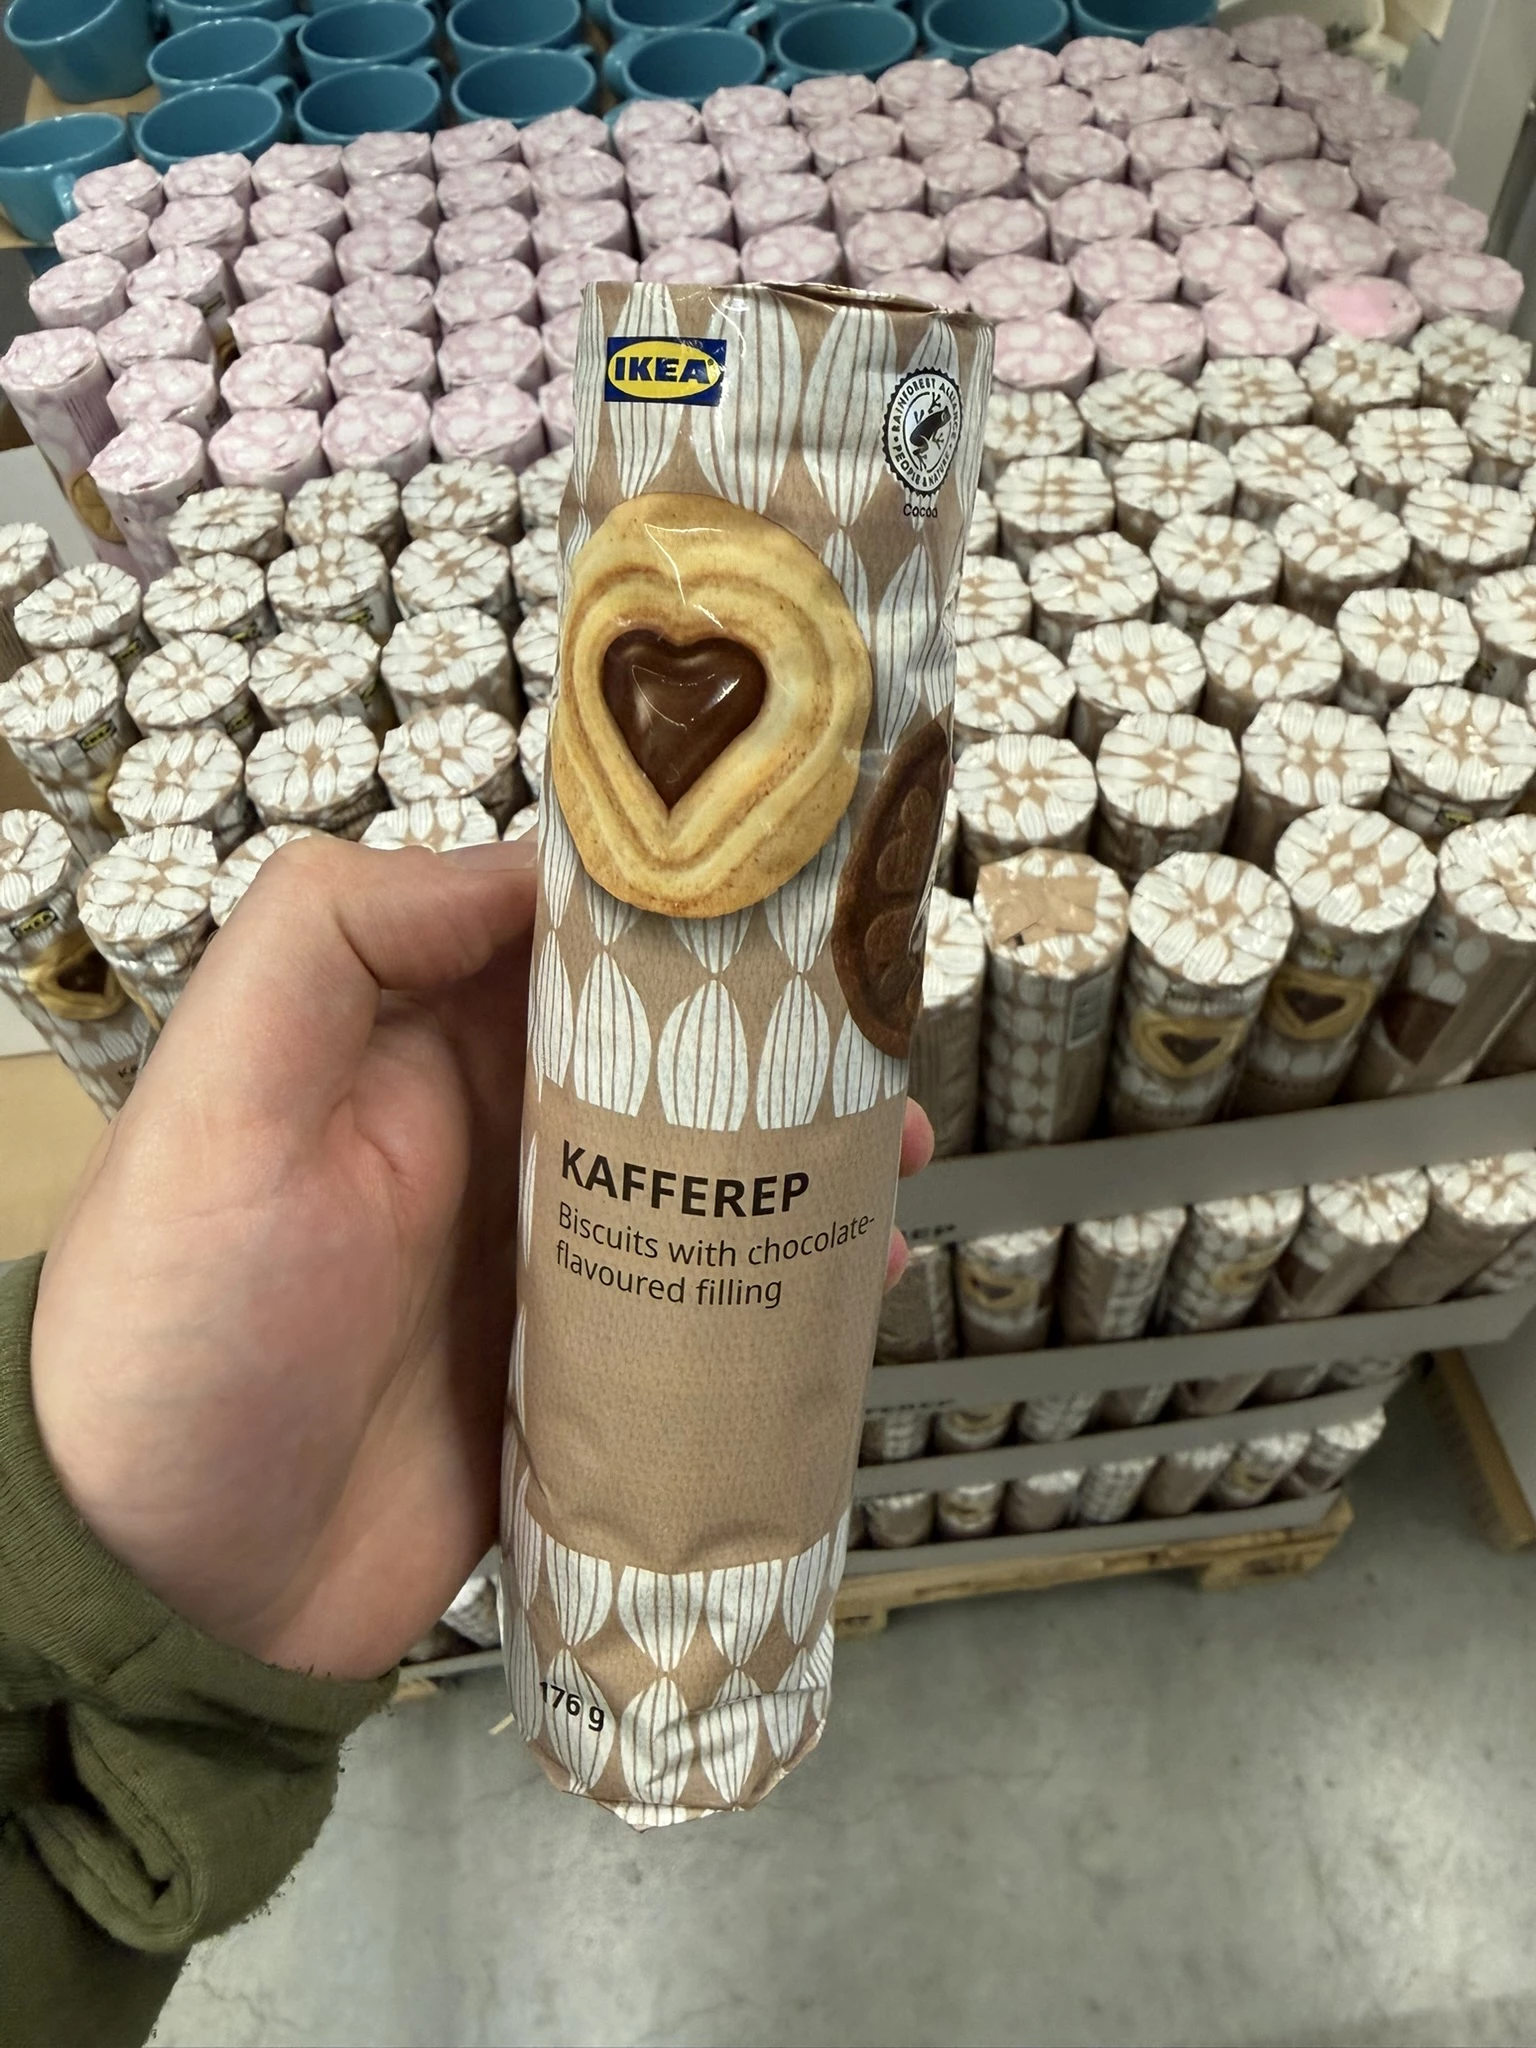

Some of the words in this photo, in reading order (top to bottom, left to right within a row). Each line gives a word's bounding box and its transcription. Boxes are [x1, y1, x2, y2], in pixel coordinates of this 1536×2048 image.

[615, 356, 711, 385] IKEA
[891, 377, 936, 433] RAINFOREST
[939, 382, 958, 439] ALLIANCE
[892, 444, 921, 487] PEOPLE
[928, 451, 951, 486] NATURE
[903, 503, 938, 519] Cocoa
[561, 1139, 810, 1217] KAFFEREP
[558, 1201, 658, 1258] Biscuits
[668, 1240, 736, 1267] with
[747, 1214, 876, 1266] chocolate-
[556, 1240, 685, 1304] flavoured
[695, 1277, 783, 1309] filling
[539, 1681, 581, 1717] 176
[588, 1705, 605, 1733] g
